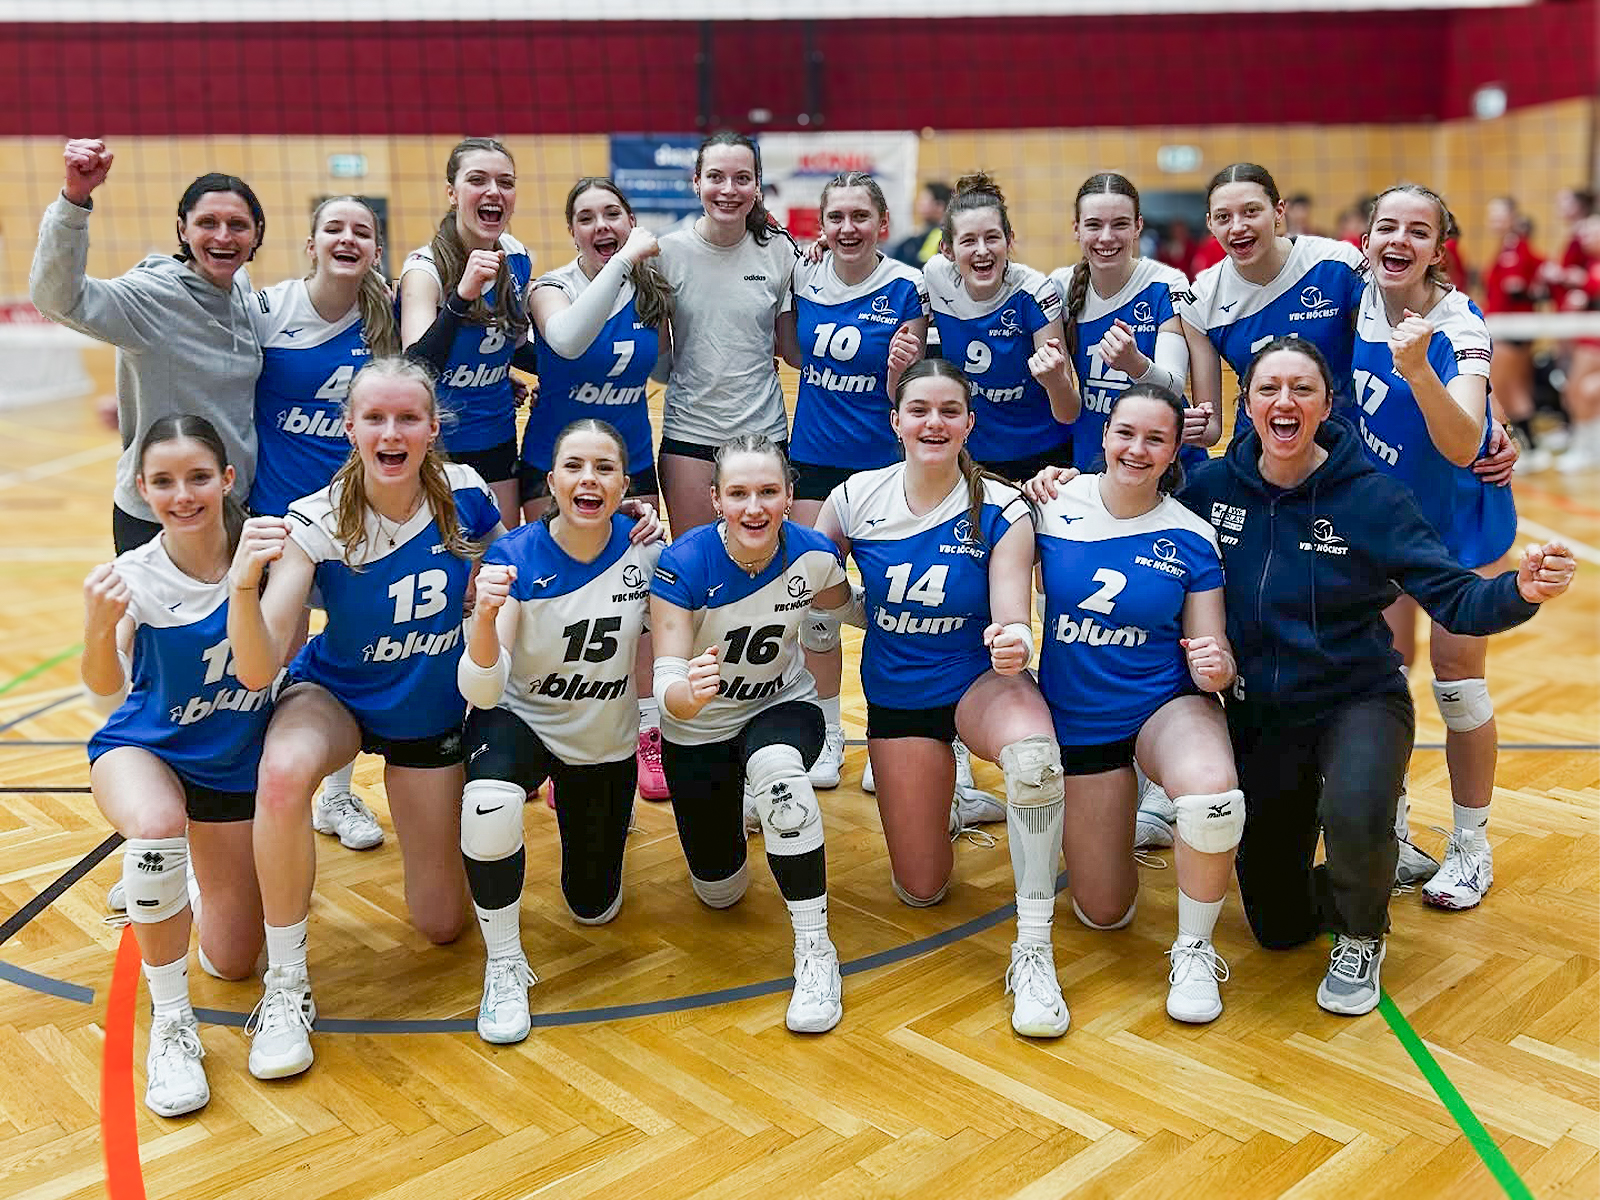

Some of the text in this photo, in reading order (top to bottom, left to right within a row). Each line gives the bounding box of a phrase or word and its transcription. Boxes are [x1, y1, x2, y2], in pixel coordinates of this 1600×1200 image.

[858, 312, 898, 325] VBC HÖCHST
[1289, 308, 1339, 321] VBC HÖCHST
[479, 317, 506, 354] 8
[812, 322, 861, 361] 10
[989, 329, 1001, 337] VBC
[606, 340, 635, 378] 7
[964, 340, 992, 374] 9
[314, 365, 355, 403] 4
[574, 382, 645, 405] blum
[807, 363, 877, 392] blum
[969, 381, 1024, 402] lum
[1352, 368, 1390, 416] 17
[1083, 387, 1117, 414] blu
[282, 407, 346, 438] blu
[1359, 416, 1400, 466] lum
[939, 544, 985, 558] VBC HÖCHST
[1134, 555, 1187, 577] VBC HÖCHST
[1316, 543, 1348, 555] HÖCHST
[388, 569, 448, 624] 13
[612, 594, 627, 603] VBC
[885, 562, 950, 607] 14
[1077, 567, 1128, 615] 2
[774, 602, 790, 612] VBC
[876, 605, 968, 634] blum
[373, 623, 461, 662] blum
[562, 616, 622, 663] 15
[723, 625, 786, 665] 16
[1056, 613, 1149, 648] blum
[202, 638, 237, 685] 1
[178, 677, 280, 725] blum
[538, 672, 628, 701] blum
